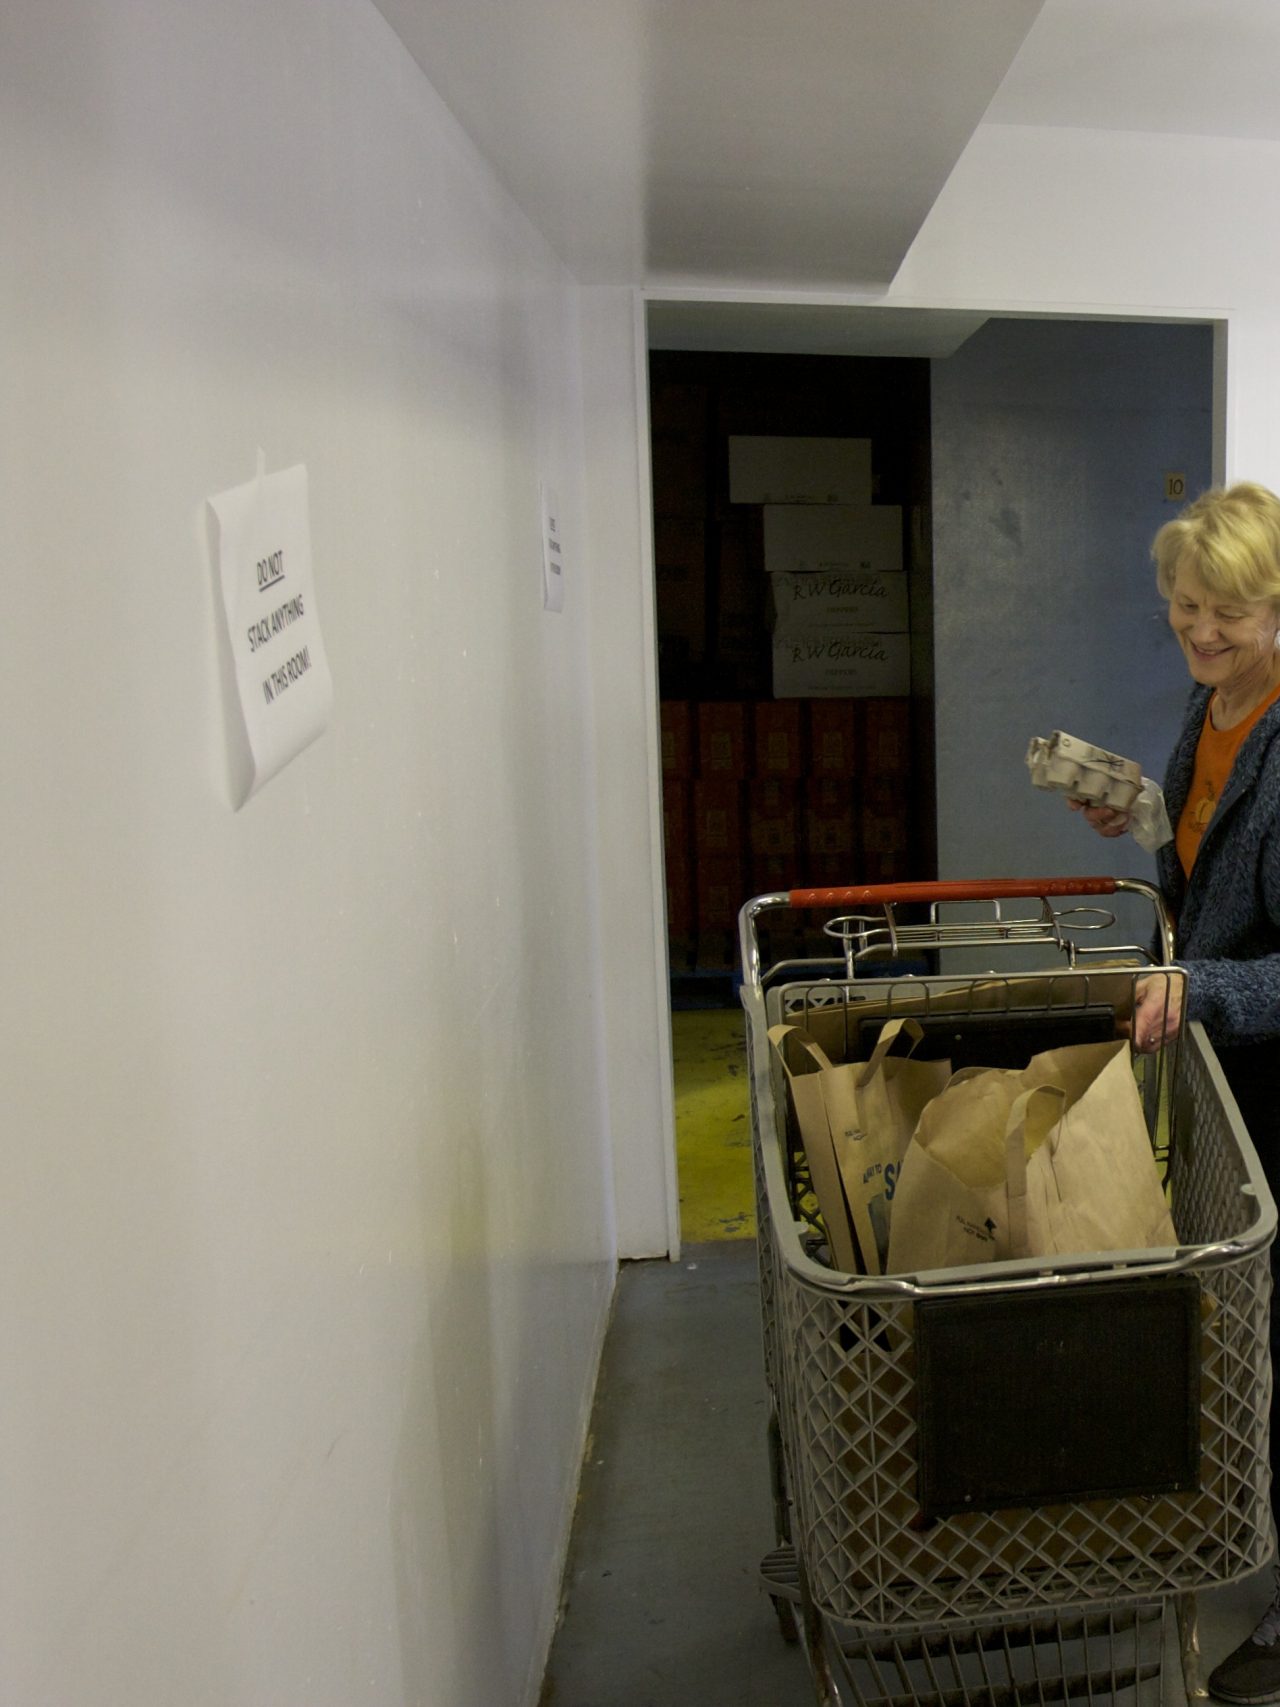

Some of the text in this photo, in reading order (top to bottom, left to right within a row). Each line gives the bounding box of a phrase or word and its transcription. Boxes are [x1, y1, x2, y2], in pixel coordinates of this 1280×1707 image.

[1169, 478, 1184, 496] 10
[257, 550, 283, 586] DO NOT
[248, 594, 304, 652] STACK ANYTHING
[262, 645, 312, 704] IN THIS ROOM!
